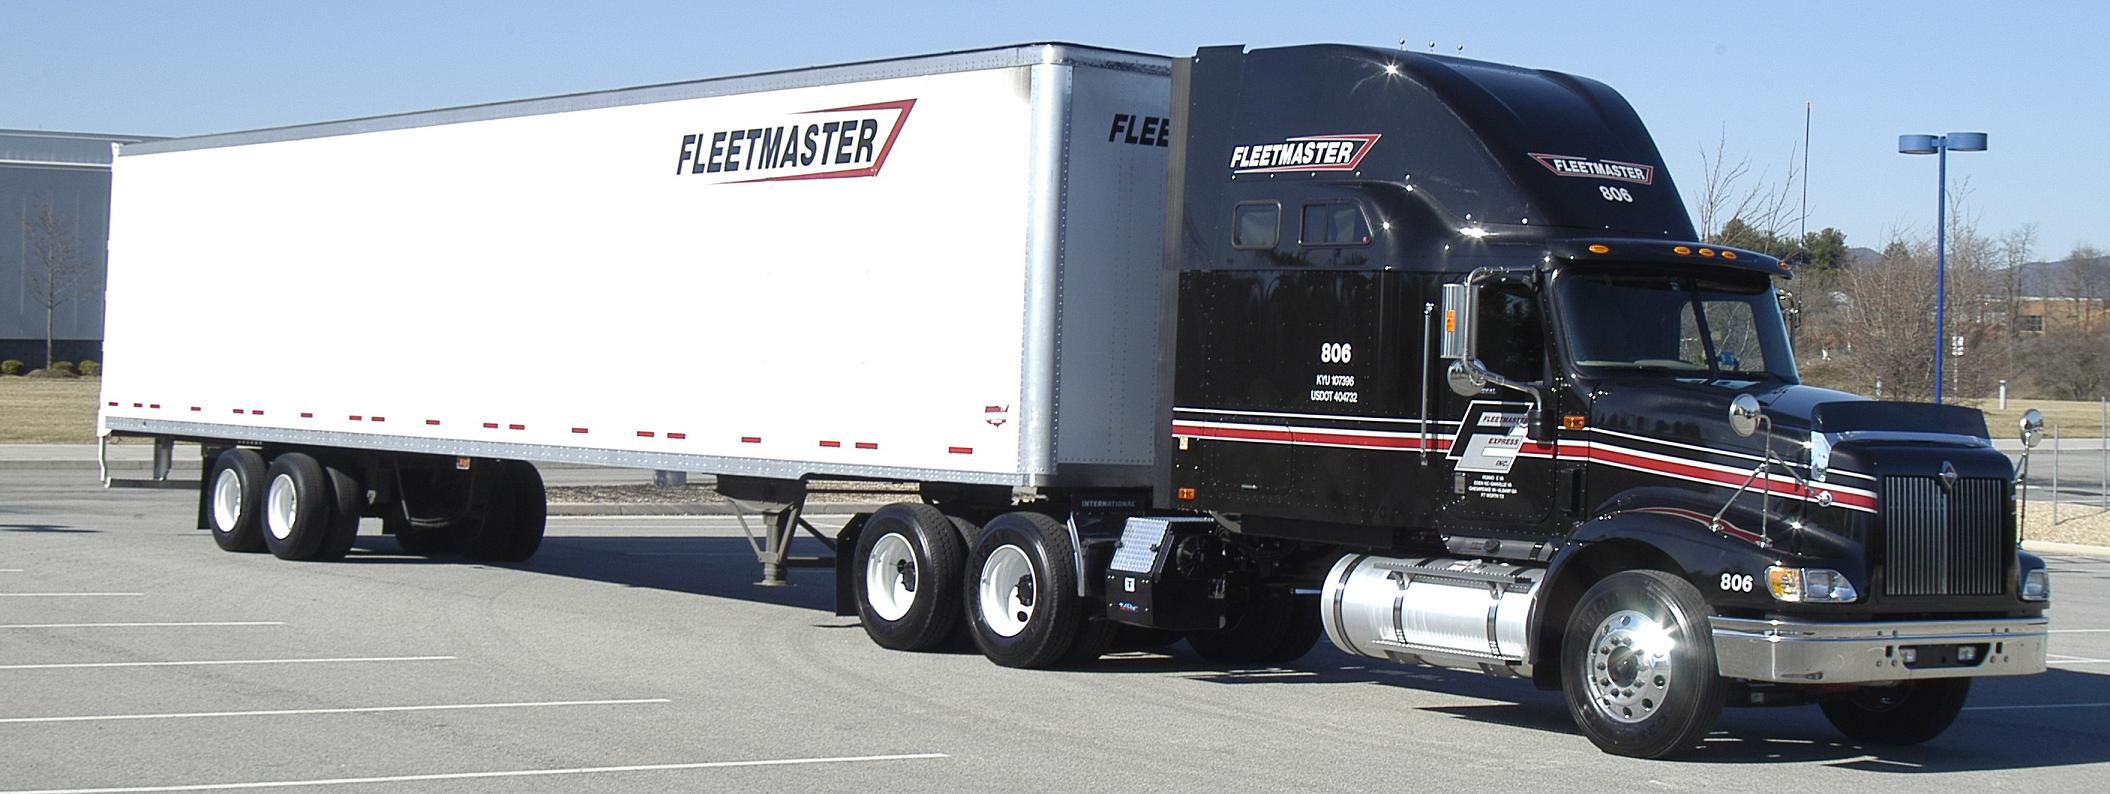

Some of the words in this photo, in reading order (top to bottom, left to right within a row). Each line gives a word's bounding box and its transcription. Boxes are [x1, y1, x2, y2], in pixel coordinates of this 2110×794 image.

[1108, 113, 1169, 148] FLEE
[676, 118, 878, 175] FLEETMASTER
[1230, 141, 1354, 168] FLEETMASTER
[1553, 159, 1646, 181] FLEETMASTER
[1599, 185, 1633, 203] 806
[1321, 342, 1352, 364] 806
[1316, 374, 1331, 386] KYU
[1310, 390, 1334, 402] USDOT
[1488, 437, 1520, 446] EXPRESS
[1081, 500, 1136, 508] INTERNATIONAL
[1720, 573, 1753, 593] 806
